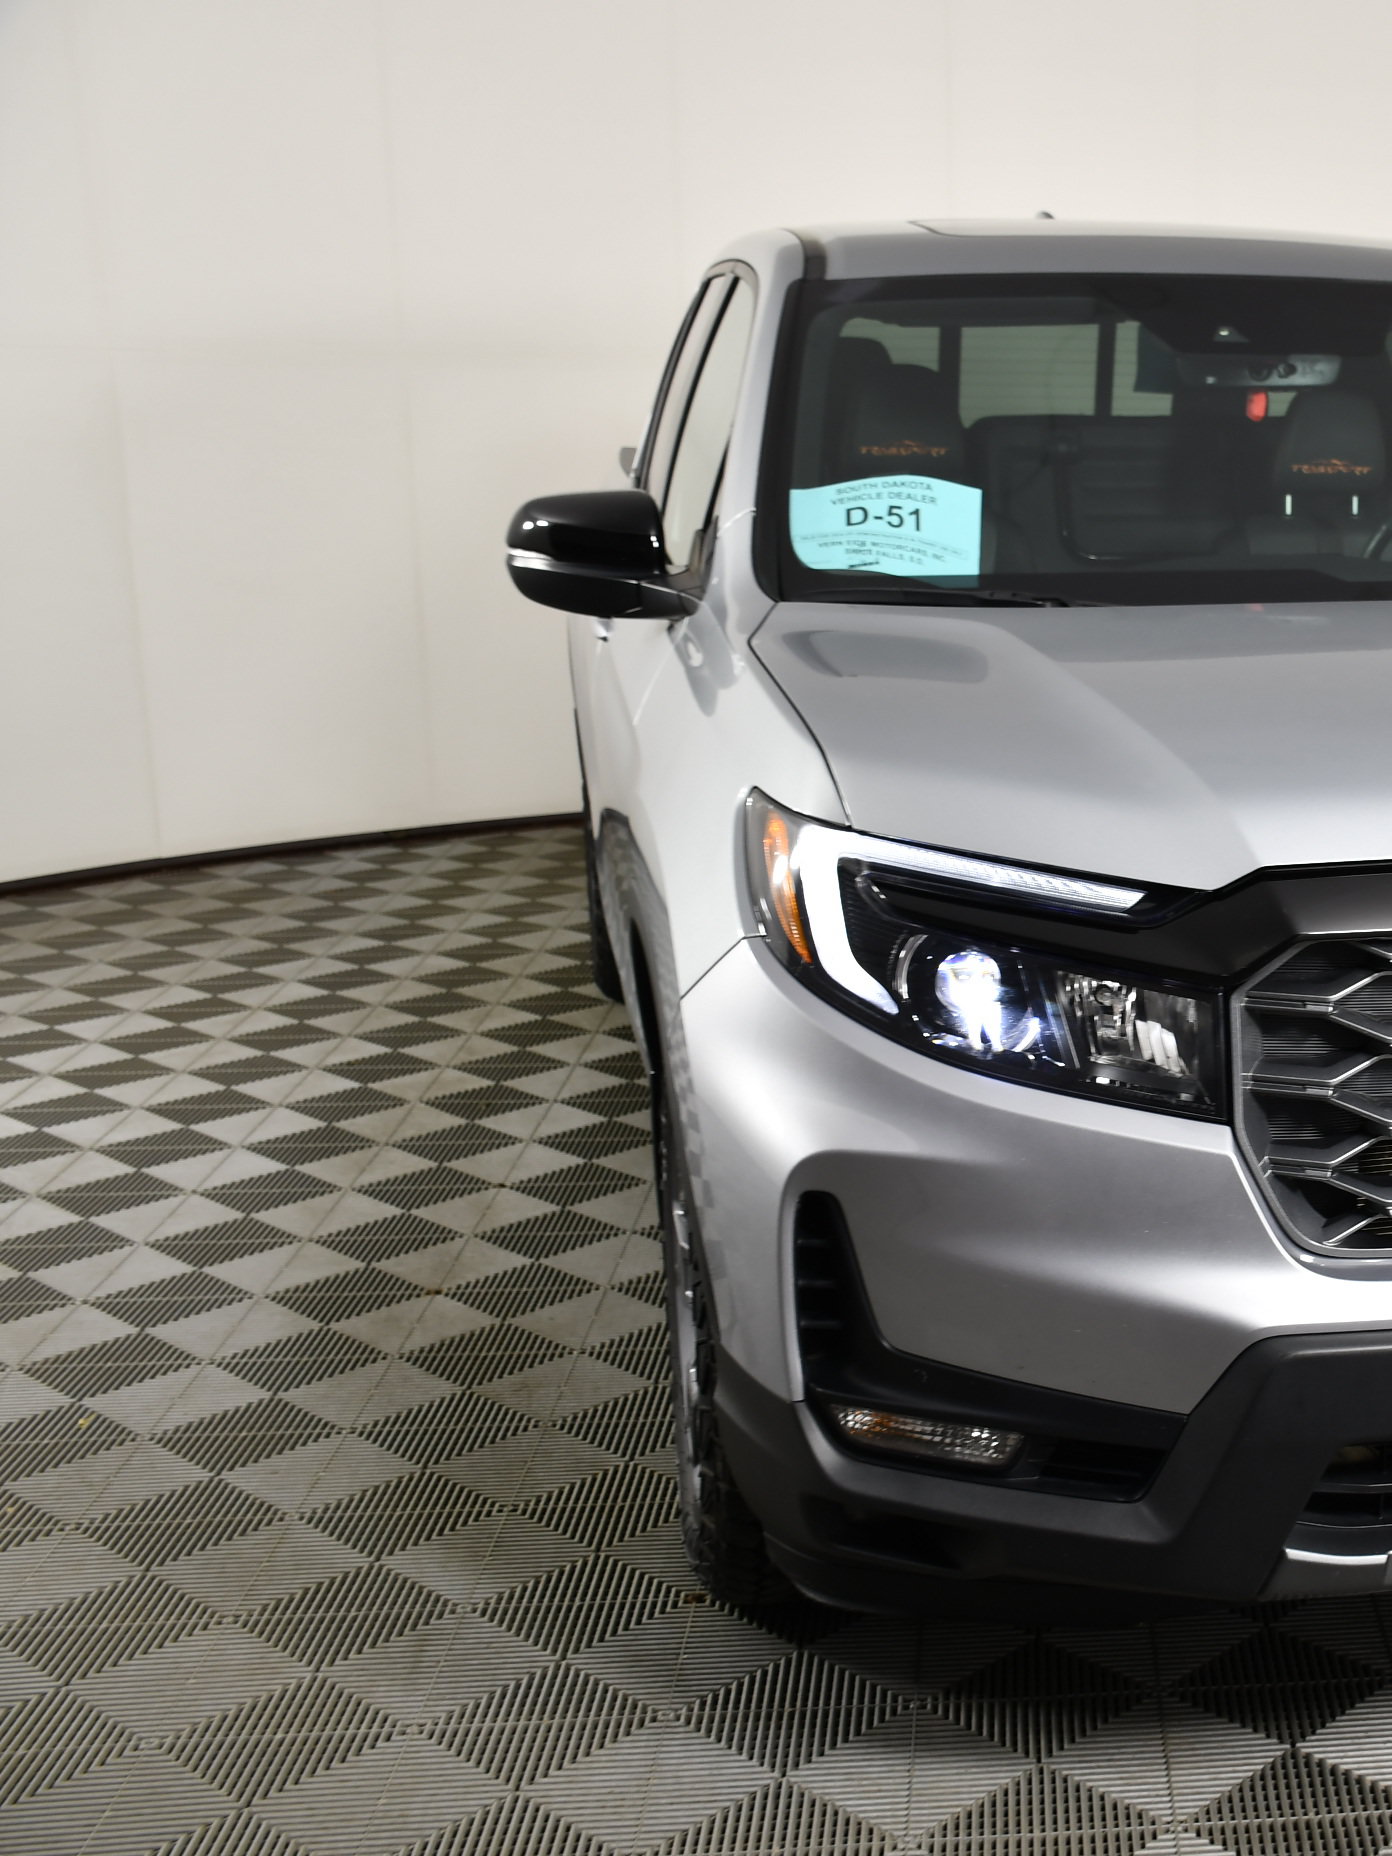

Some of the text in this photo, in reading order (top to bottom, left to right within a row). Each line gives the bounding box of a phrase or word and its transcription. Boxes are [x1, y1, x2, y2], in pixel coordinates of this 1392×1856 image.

[836, 479, 934, 496] SOUTH DAKOTA
[831, 491, 938, 506] VEHICLE DEALER
[845, 505, 922, 532] D-51
